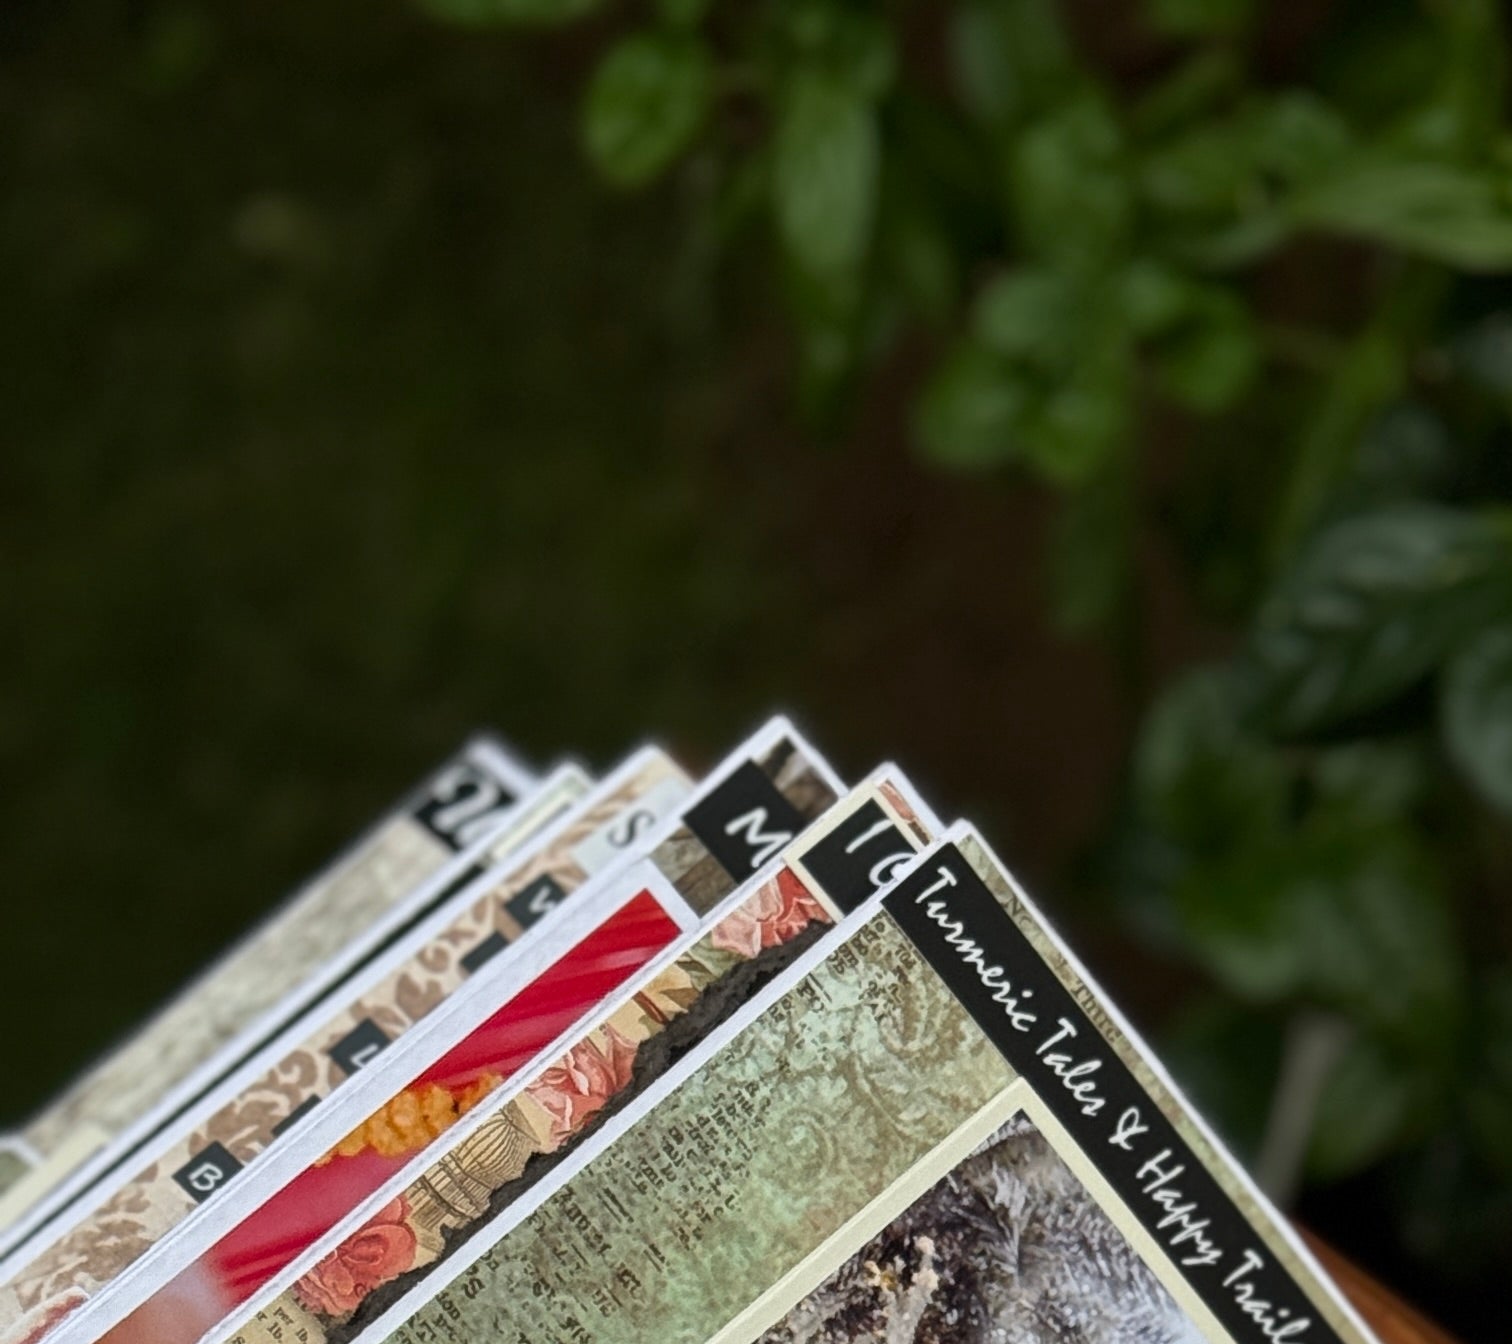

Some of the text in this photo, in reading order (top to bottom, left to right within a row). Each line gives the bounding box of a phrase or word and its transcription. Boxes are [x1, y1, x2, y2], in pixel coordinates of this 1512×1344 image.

[915, 866, 1037, 1032] Turmeric
[1035, 1017, 1106, 1117] Tales
[1135, 1148, 1223, 1266] Happy
